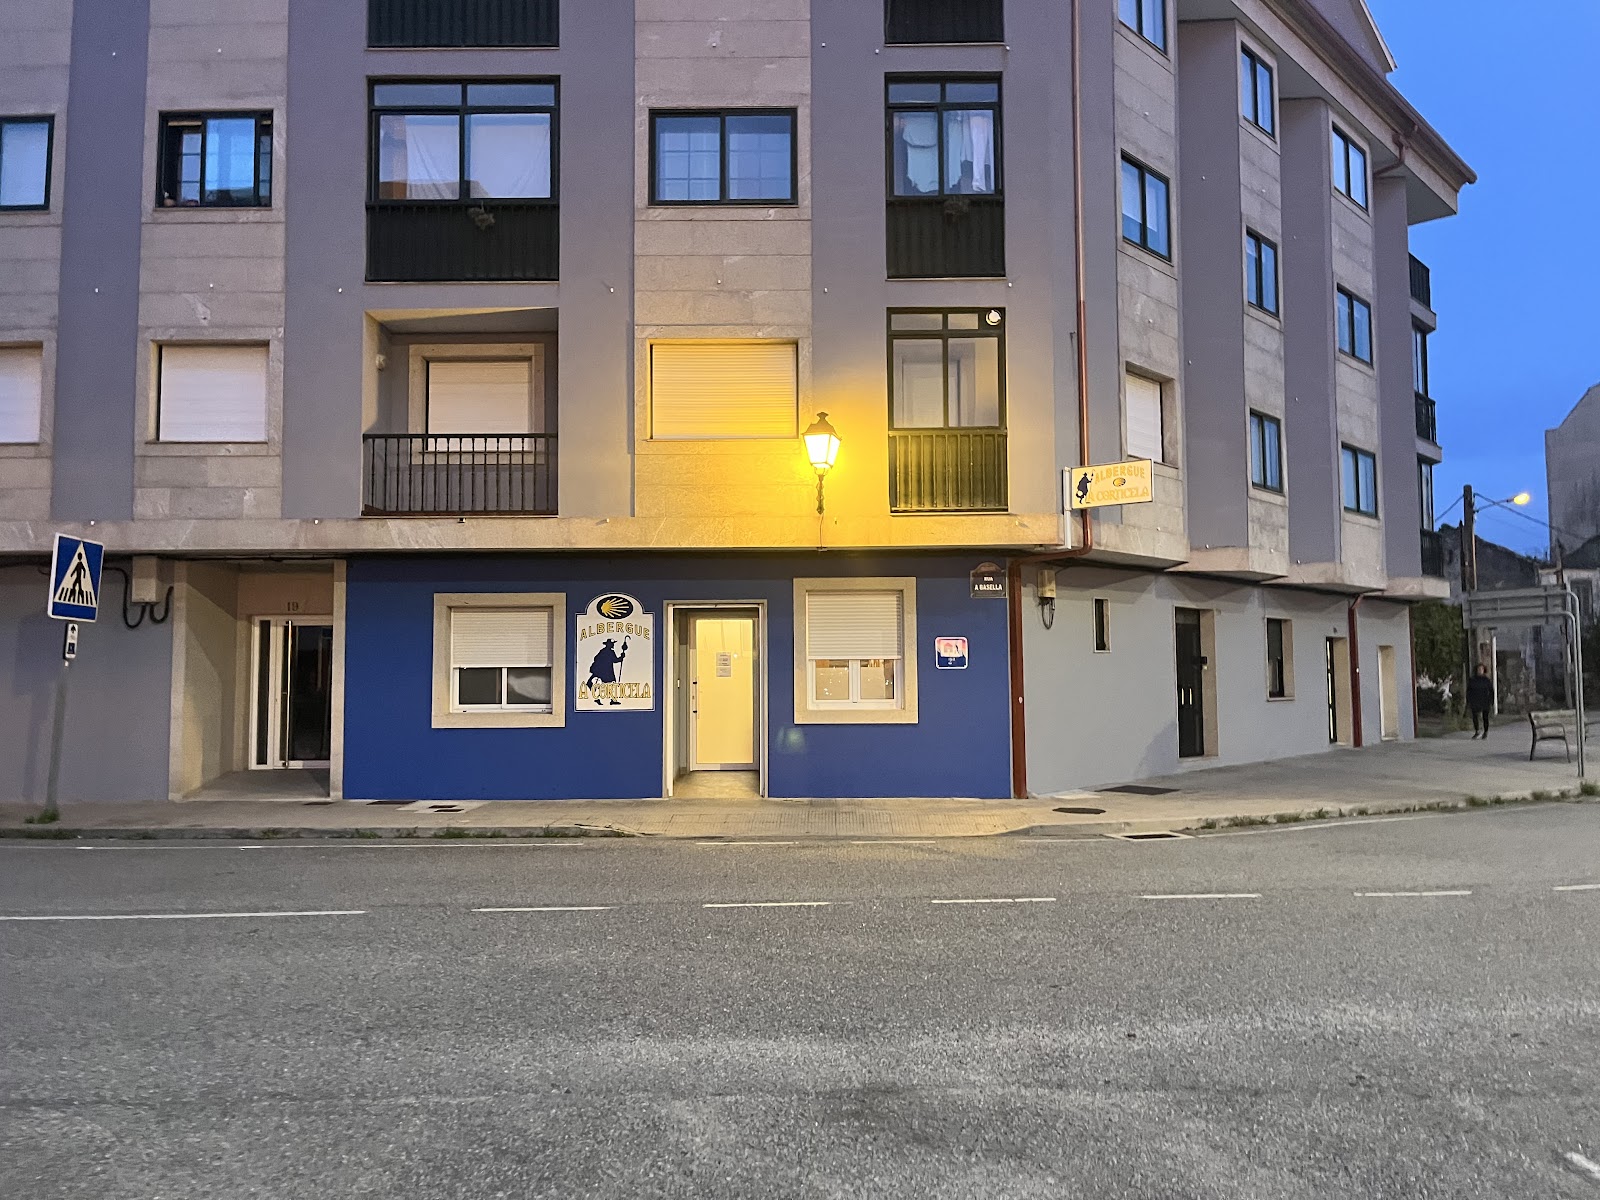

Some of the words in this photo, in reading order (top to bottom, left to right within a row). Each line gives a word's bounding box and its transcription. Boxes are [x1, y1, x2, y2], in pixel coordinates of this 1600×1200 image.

[1095, 465, 1145, 484] ALBERGUE
[1085, 491, 1095, 502] A
[1096, 486, 1149, 501] CORTICELA
[580, 622, 651, 641] ALBERGUE
[578, 681, 588, 699] A
[591, 682, 651, 700] CORTICELA
